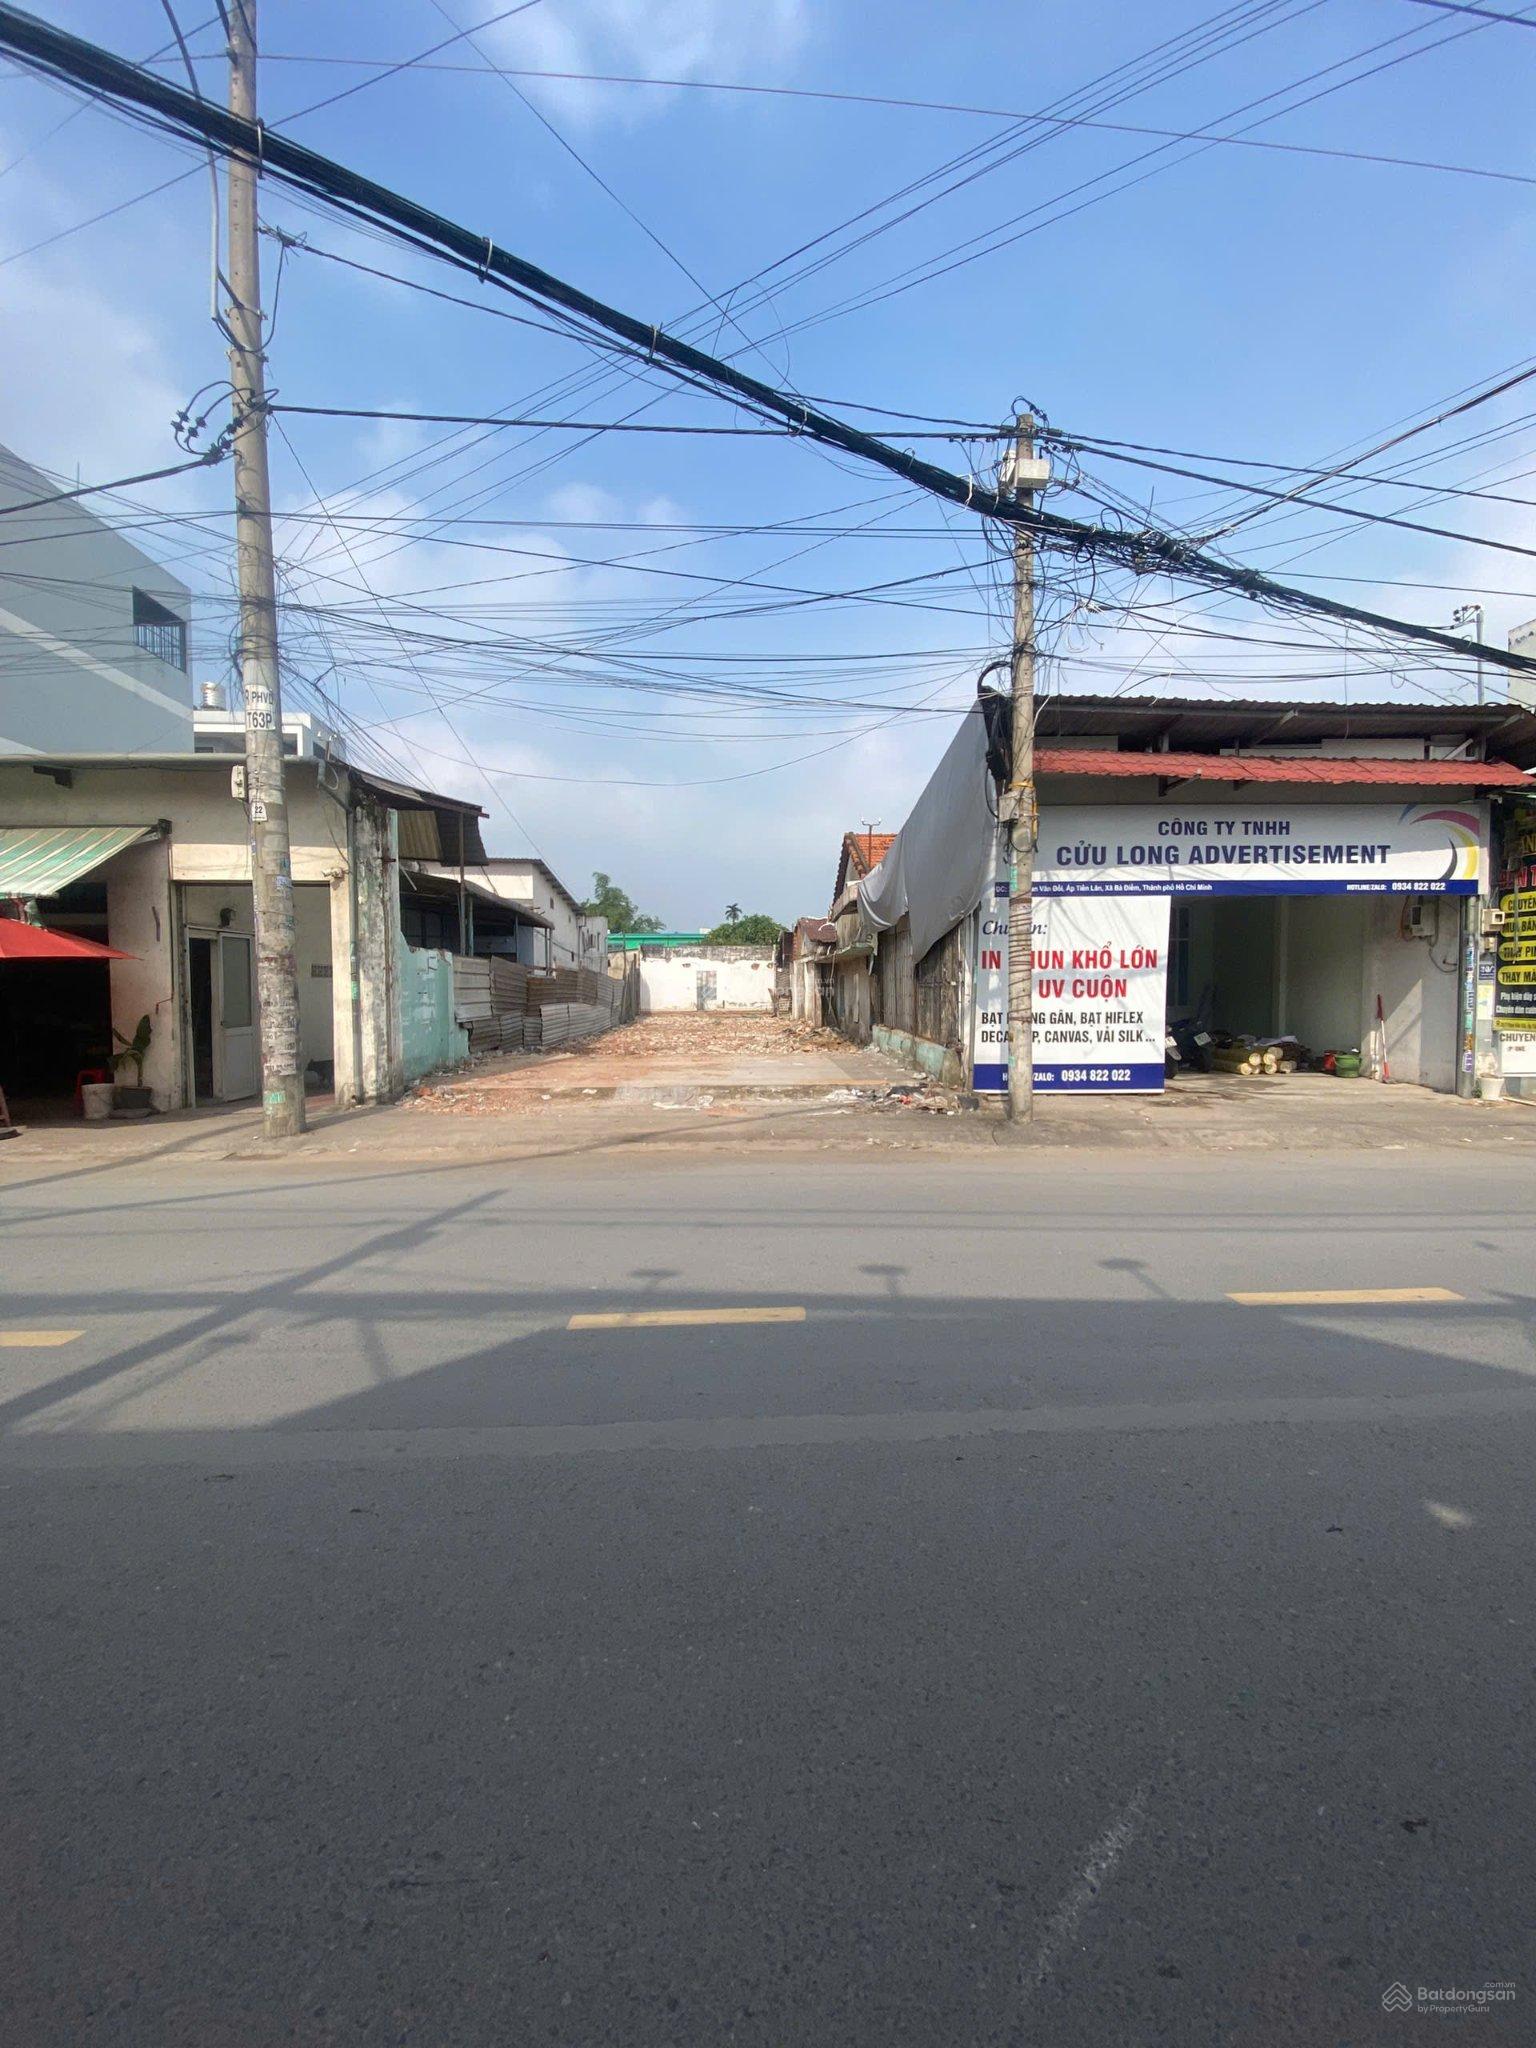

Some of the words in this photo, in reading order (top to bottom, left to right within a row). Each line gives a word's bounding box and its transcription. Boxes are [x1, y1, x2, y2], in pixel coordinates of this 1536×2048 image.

[1158, 818, 1207, 836] CÔNG
[1214, 821, 1235, 835] TY
[1242, 821, 1290, 835] TNHH
[1056, 840, 1107, 866] CỬU
[1117, 845, 1179, 865] LONG
[1189, 845, 1391, 864] ADVERTISEMENT
[1143, 883, 1161, 891] Thành
[1163, 882, 1174, 891] phố
[1176, 881, 1185, 890] Hồ
[1186, 882, 1196, 890] Chí
[1197, 882, 1212, 890] Minh
[1392, 882, 1412, 891] 0934
[1414, 882, 1428, 891] 822
[1430, 882, 1446, 891] 022
[981, 950, 1001, 969] IN
[1072, 941, 1112, 969] KHỔ
[1120, 945, 1157, 969] LỚN
[1502, 971, 1520, 983] THAY
[1038, 979, 1065, 998] UV
[1072, 974, 1127, 1002] CUỘN
[981, 1012, 1003, 1027] BẠT
[1050, 1010, 1077, 1025] GÂN,
[1080, 1012, 1103, 1027] BẠT
[1105, 1011, 1143, 1024] HIFLEX
[1045, 1030, 1092, 1044] CANVAS,
[1096, 1026, 1115, 1042] VẢI
[1061, 1070, 1086, 1082] 0934
[1090, 1070, 1108, 1082] 822
[1112, 1069, 1130, 1081] 022
